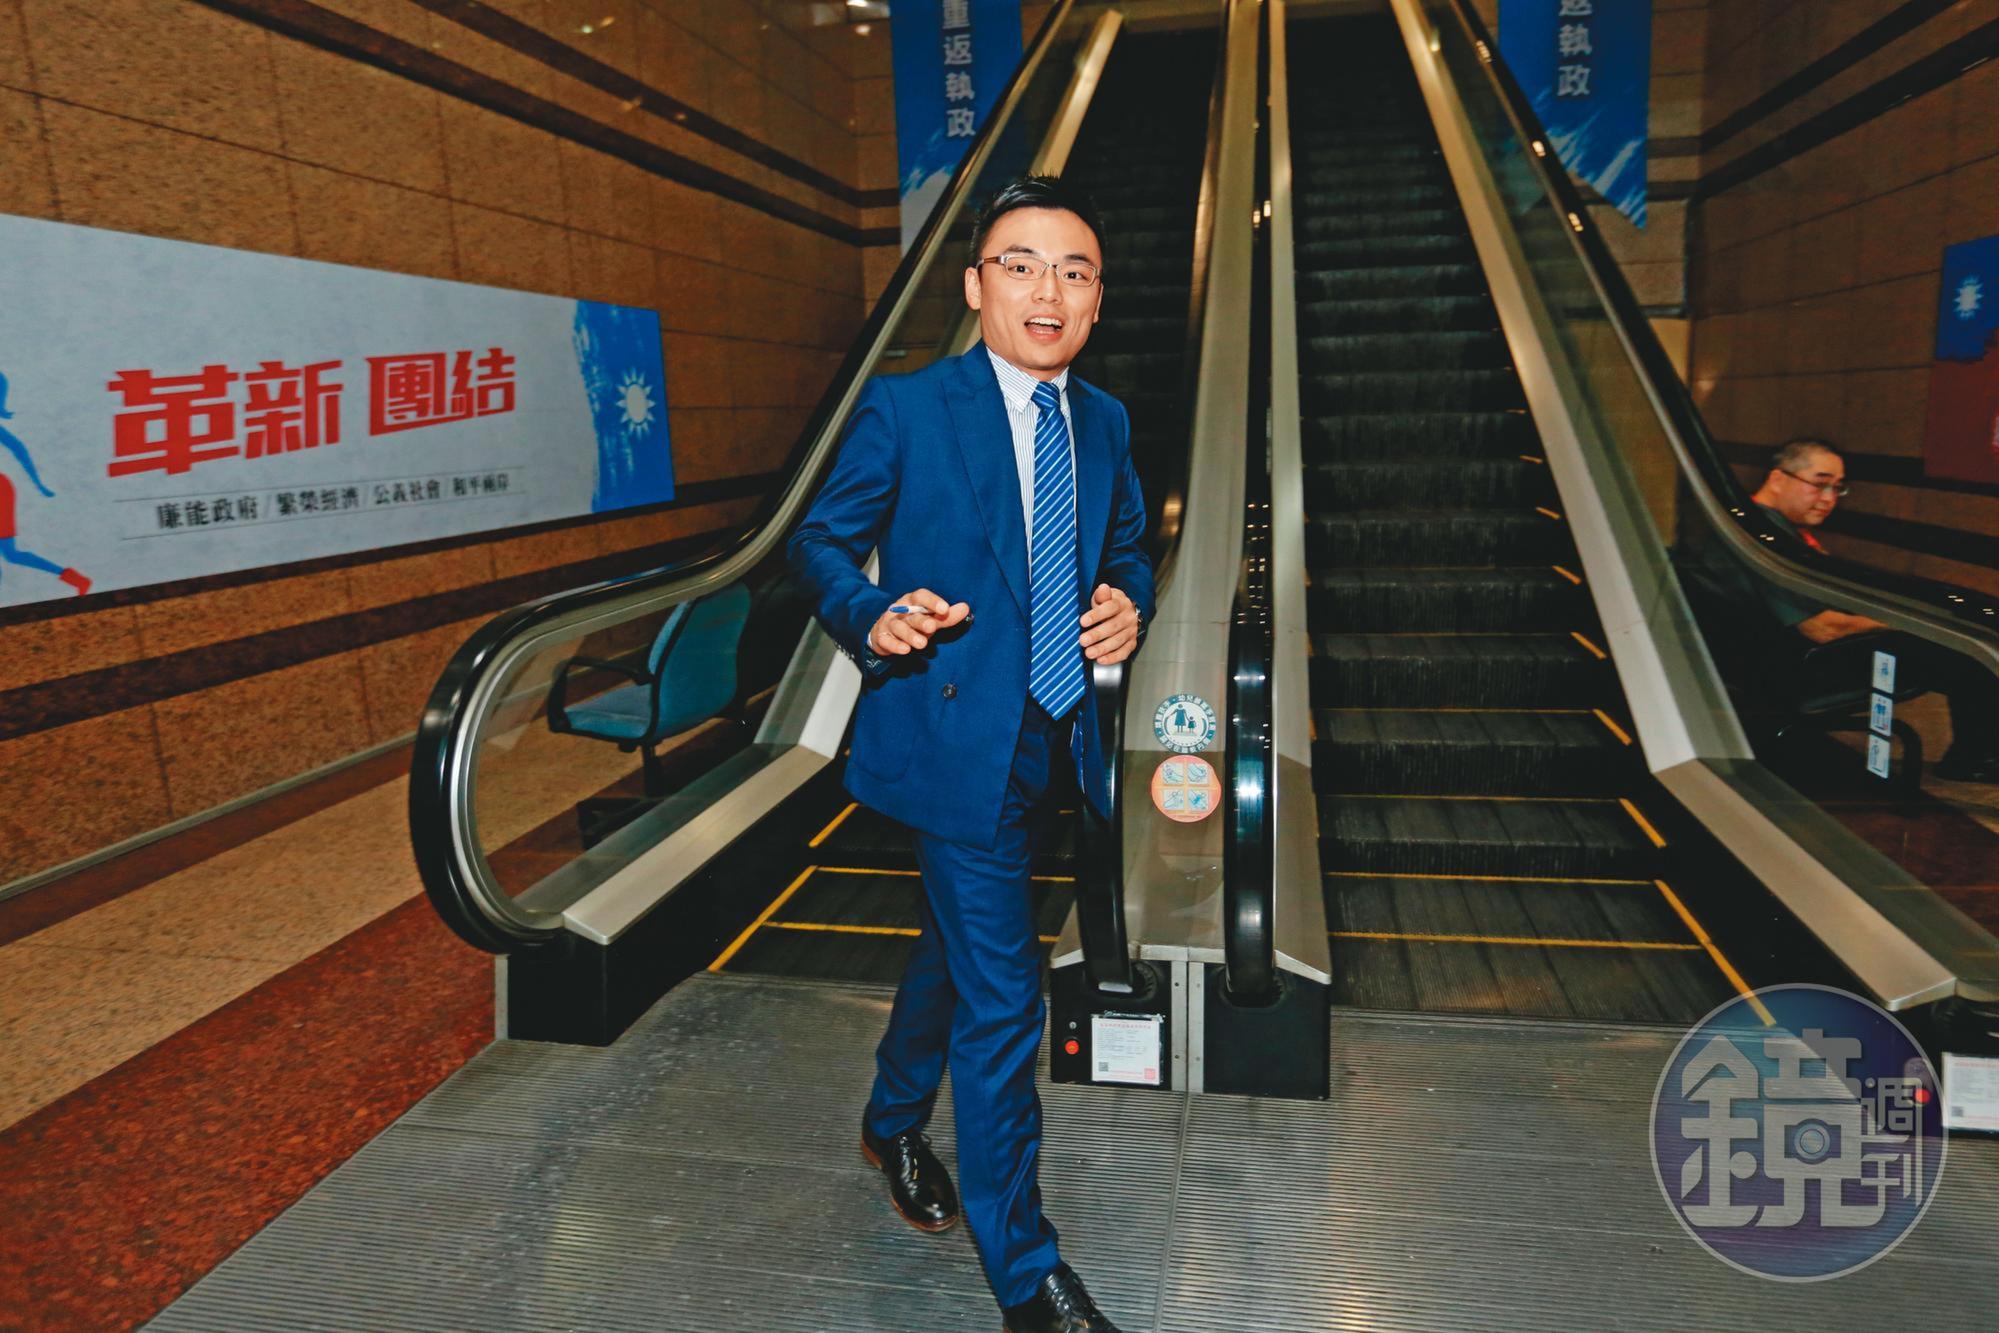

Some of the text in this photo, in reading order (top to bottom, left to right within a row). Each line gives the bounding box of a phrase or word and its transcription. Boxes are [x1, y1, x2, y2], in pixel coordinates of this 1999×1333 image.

[106, 346, 516, 477] 革新 團結
[157, 497, 258, 529] 廉能政府
